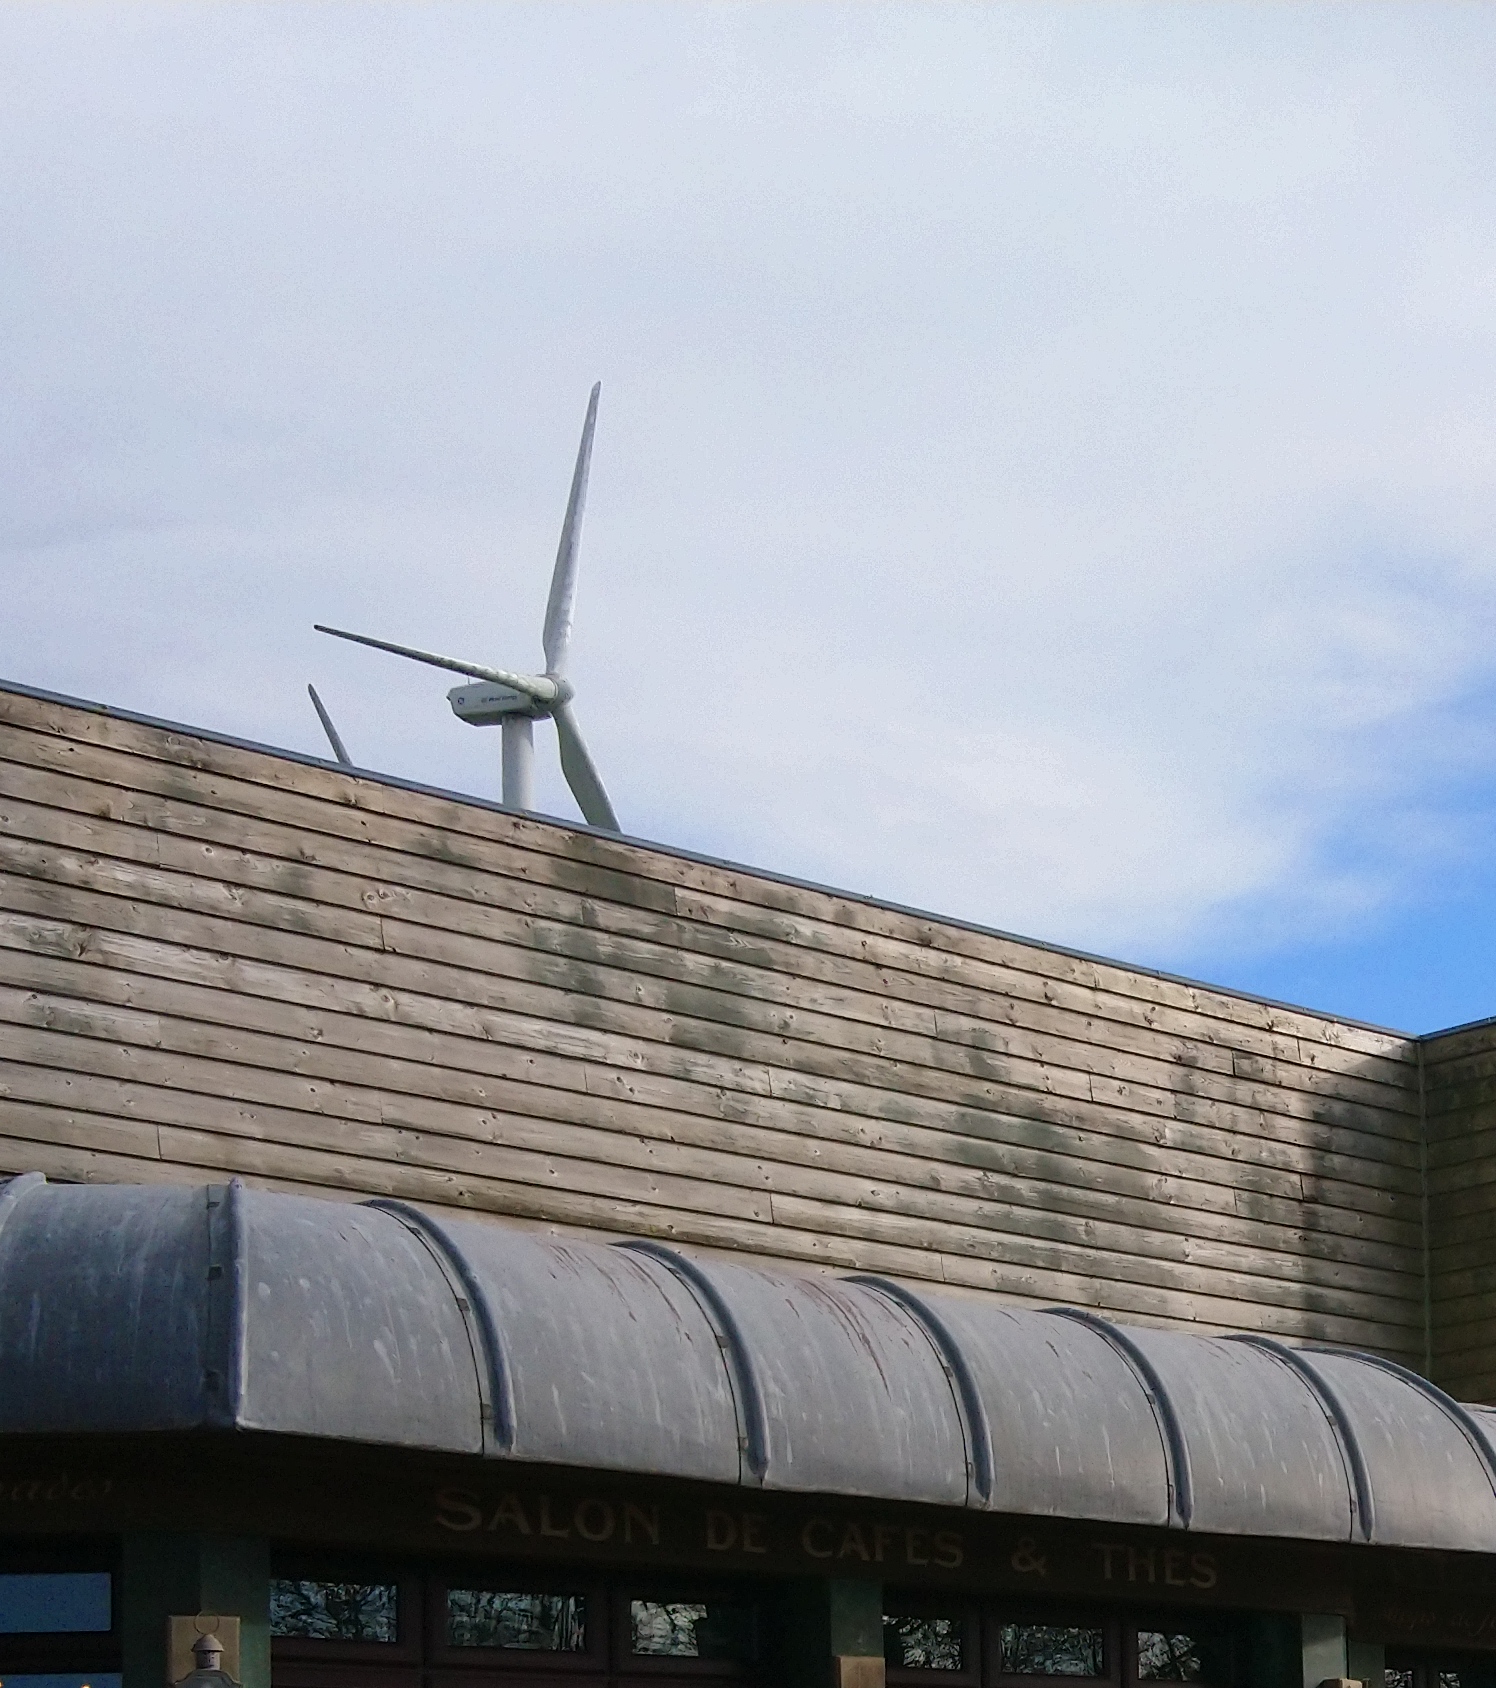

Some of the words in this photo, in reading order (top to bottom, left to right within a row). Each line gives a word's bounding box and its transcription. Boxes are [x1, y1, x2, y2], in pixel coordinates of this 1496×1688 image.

[435, 1486, 661, 1545] SALON
[705, 1509, 768, 1554] DE
[1011, 1536, 1047, 1577] &
